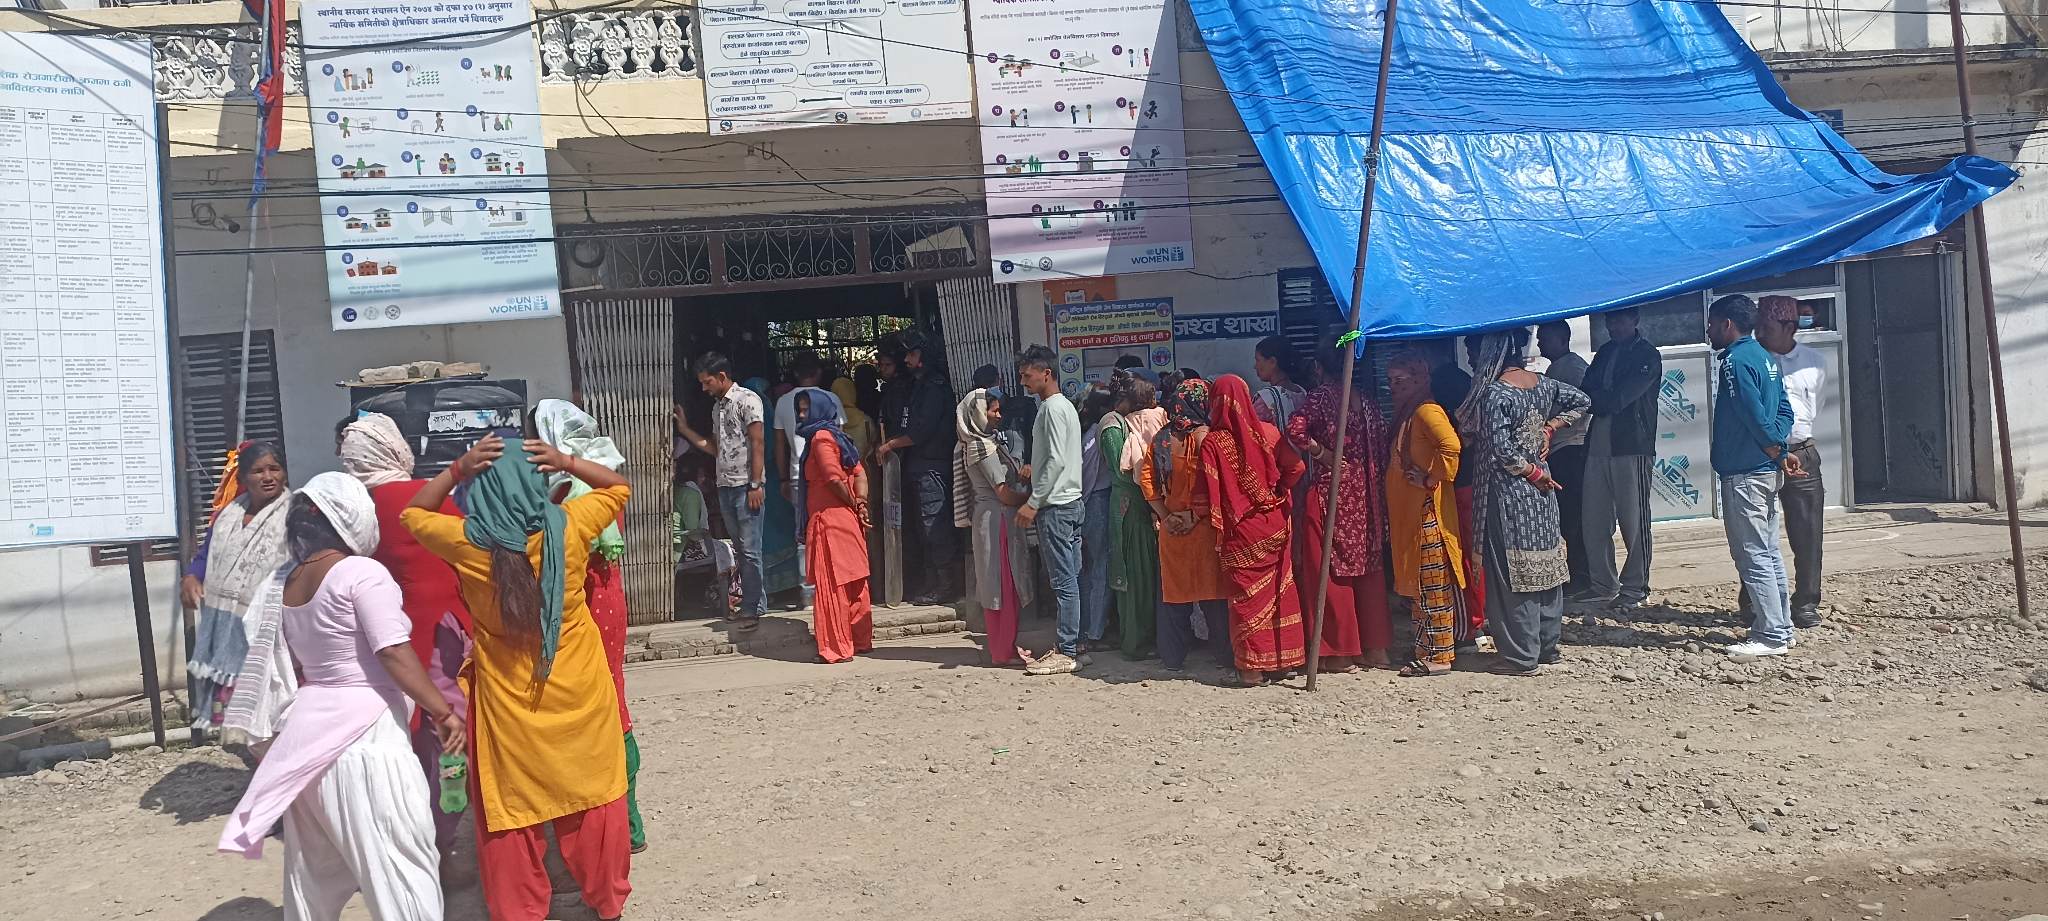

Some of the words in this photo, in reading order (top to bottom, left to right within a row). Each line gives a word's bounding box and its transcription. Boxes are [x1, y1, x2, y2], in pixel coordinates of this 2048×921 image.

[317, 7, 343, 17] स्थानीय
[400, 4, 411, 14] ऐन
[434, 3, 444, 12] को
[446, 4, 460, 12] दफा
[488, 2, 513, 11] अनुसार
[329, 19, 356, 29] न्यायिक
[61, 86, 85, 96] लागि
[1155, 247, 1169, 255] UN
[1131, 255, 1169, 265] WOMEN
[515, 296, 531, 304] UN
[489, 304, 532, 314] WOMEN
[1174, 318, 1220, 336] जश्व
[1223, 315, 1276, 334] शाखा
[1655, 458, 1699, 504] NEXA
[1658, 477, 1682, 501] COMPOSITE
